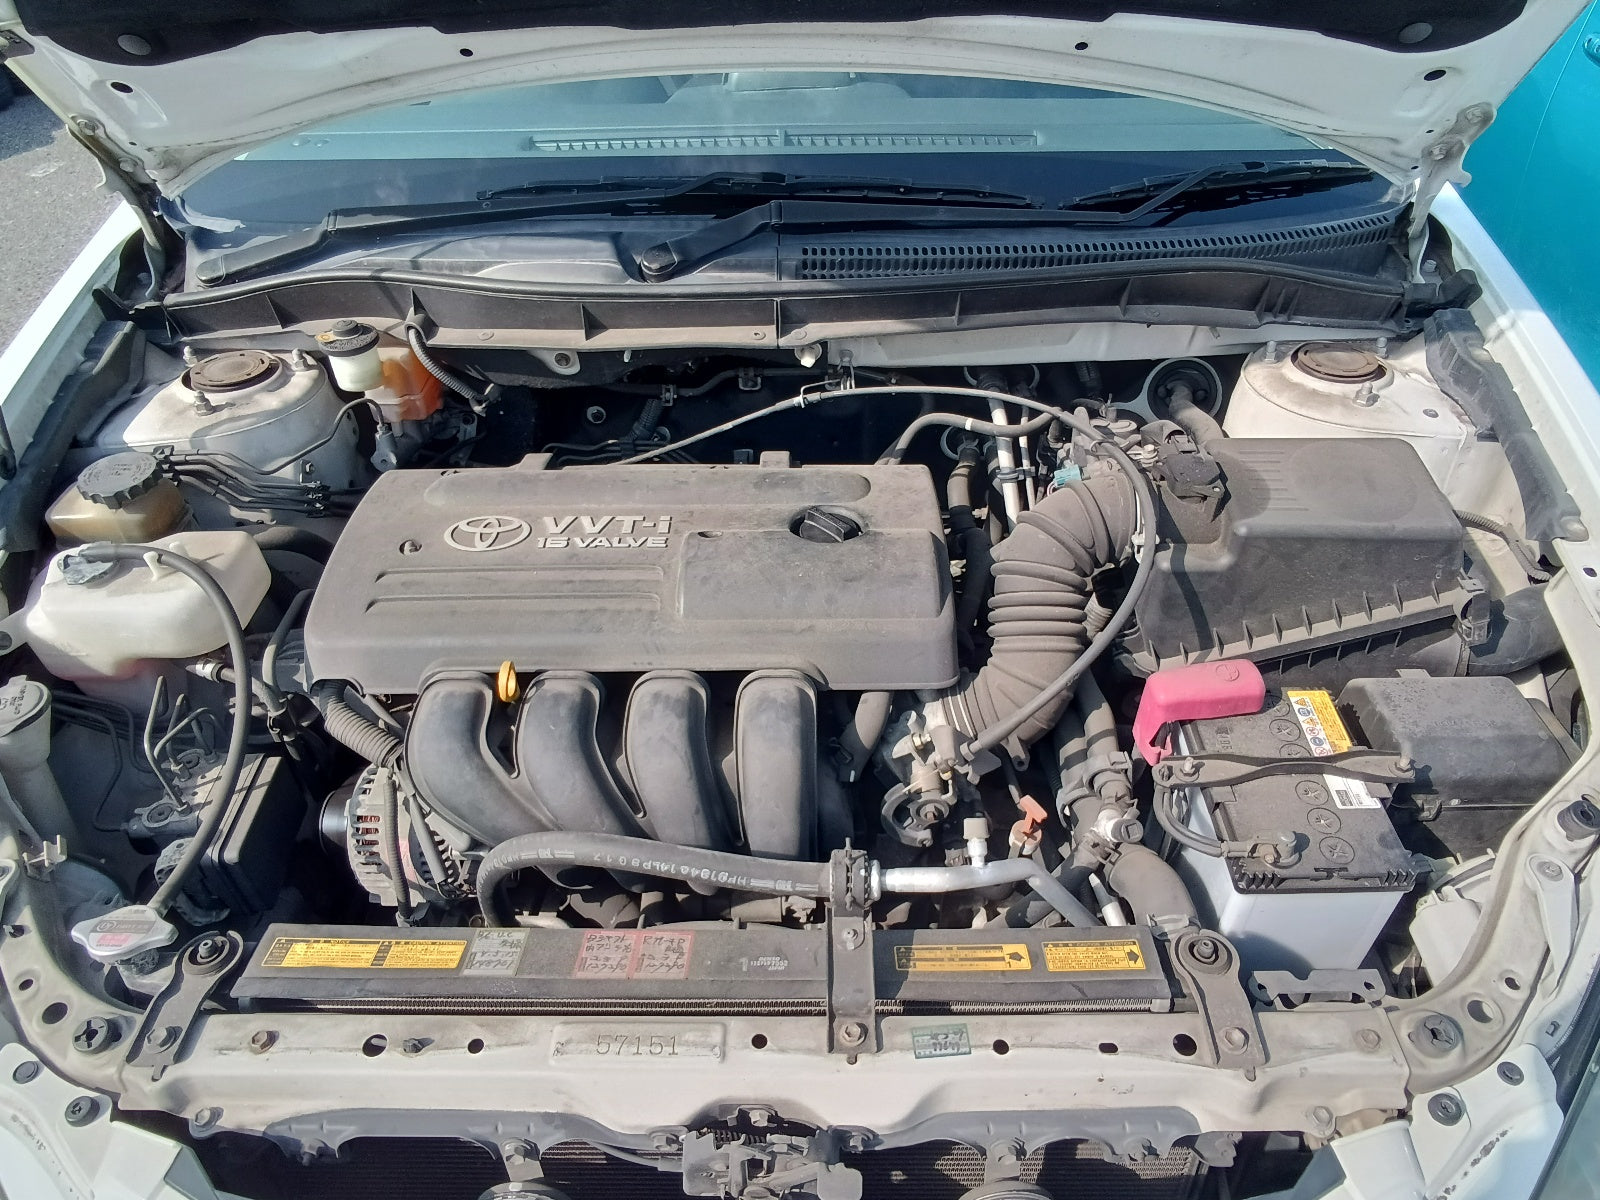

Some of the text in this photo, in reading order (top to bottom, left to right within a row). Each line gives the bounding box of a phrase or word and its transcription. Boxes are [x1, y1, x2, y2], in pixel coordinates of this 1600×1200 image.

[542, 515, 674, 535] VVT-i
[537, 536, 668, 549] 16 VALVE
[595, 1034, 680, 1056] 57151
